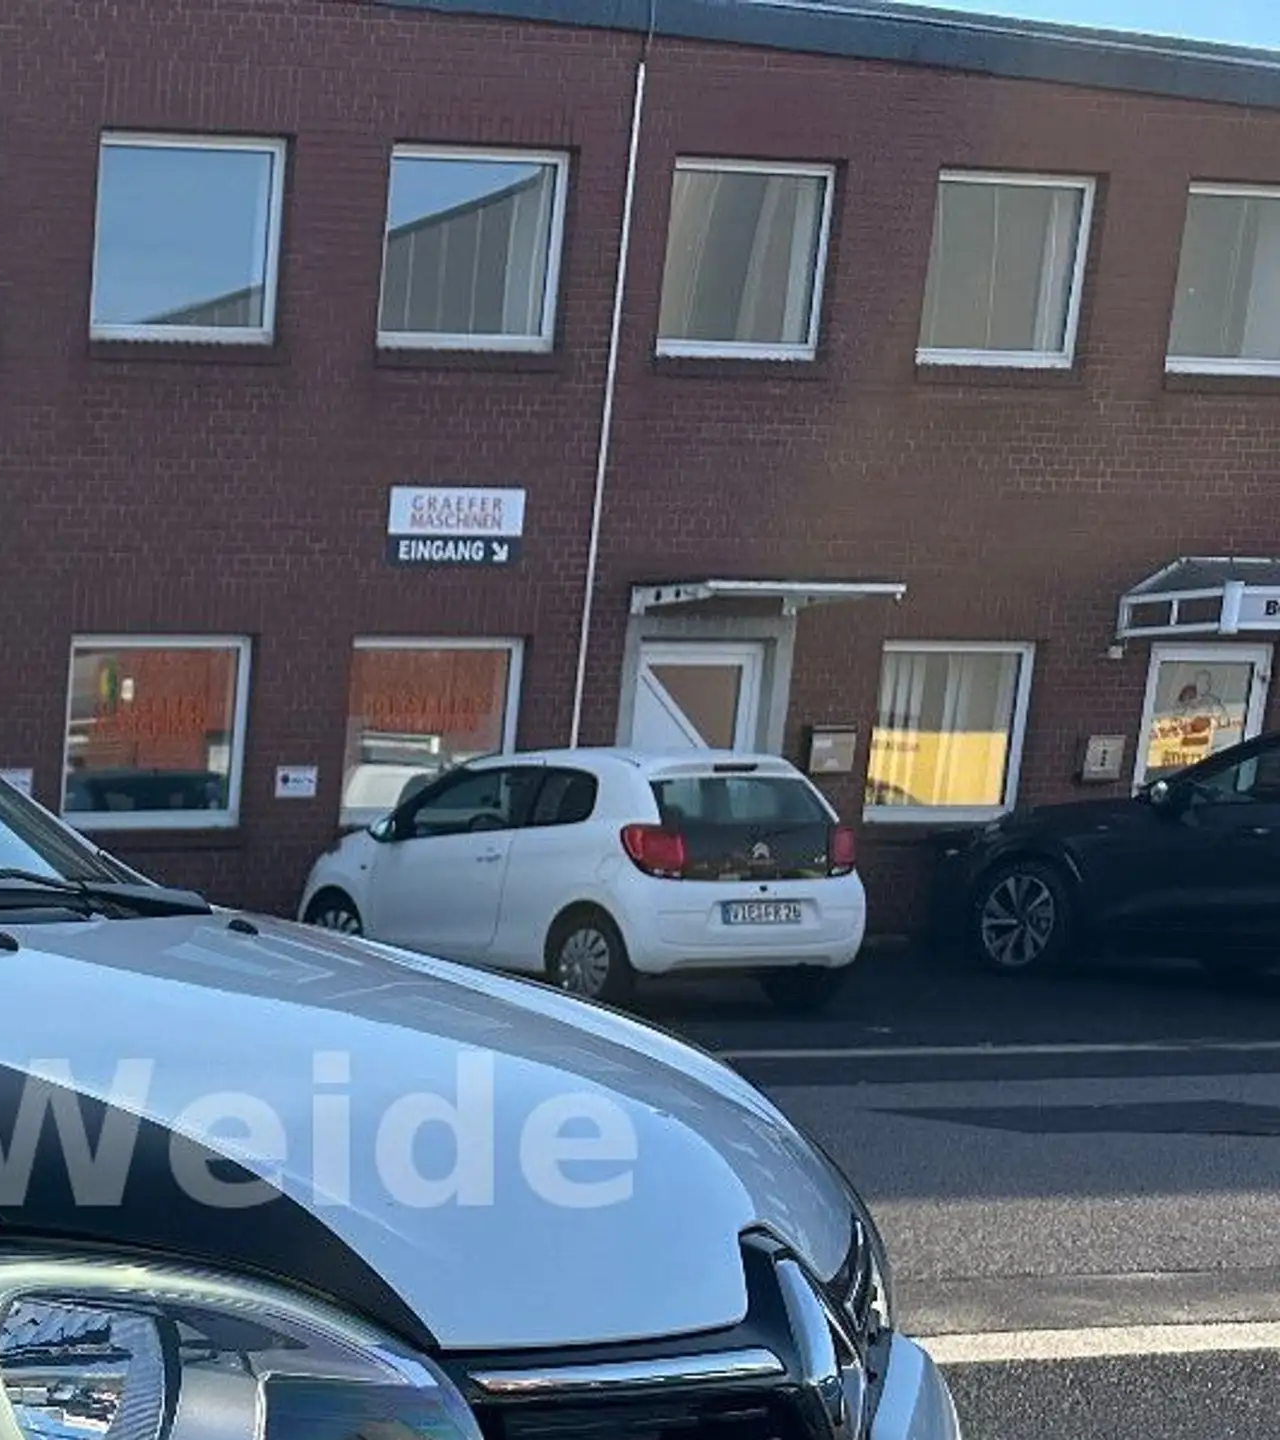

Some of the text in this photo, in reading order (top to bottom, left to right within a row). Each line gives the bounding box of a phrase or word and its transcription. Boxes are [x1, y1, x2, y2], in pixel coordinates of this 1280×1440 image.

[411, 494, 502, 512] GRAEFER
[410, 512, 502, 530] MASCHINEN
[398, 539, 484, 561] EINGANG
